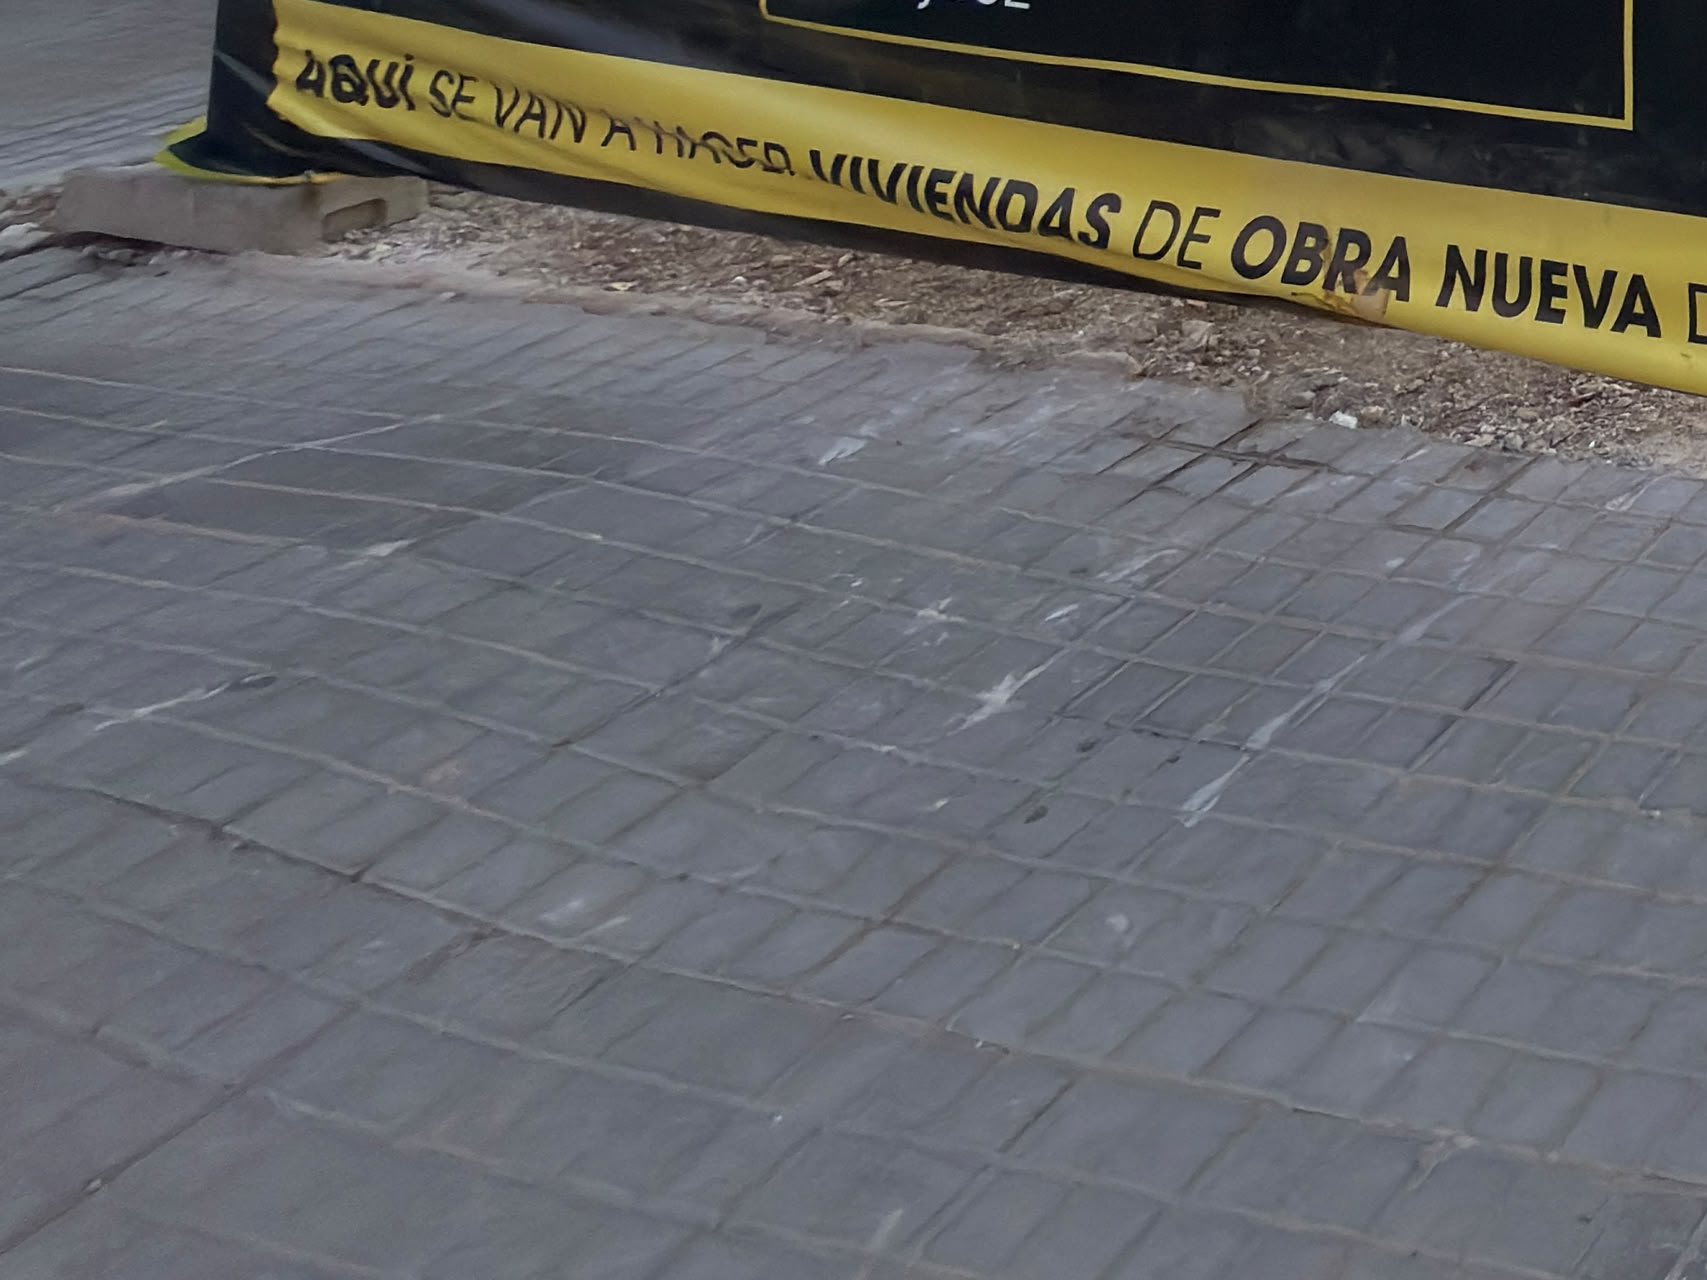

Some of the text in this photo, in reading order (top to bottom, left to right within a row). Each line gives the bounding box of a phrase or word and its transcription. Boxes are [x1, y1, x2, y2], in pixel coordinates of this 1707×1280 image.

[427, 68, 478, 122] SE
[491, 80, 588, 144] VAN
[808, 148, 1122, 250] VIVIENDAS
[1132, 199, 1222, 270] DE
[1229, 214, 1412, 303] OBRA
[1434, 243, 1663, 339] NUEVA
